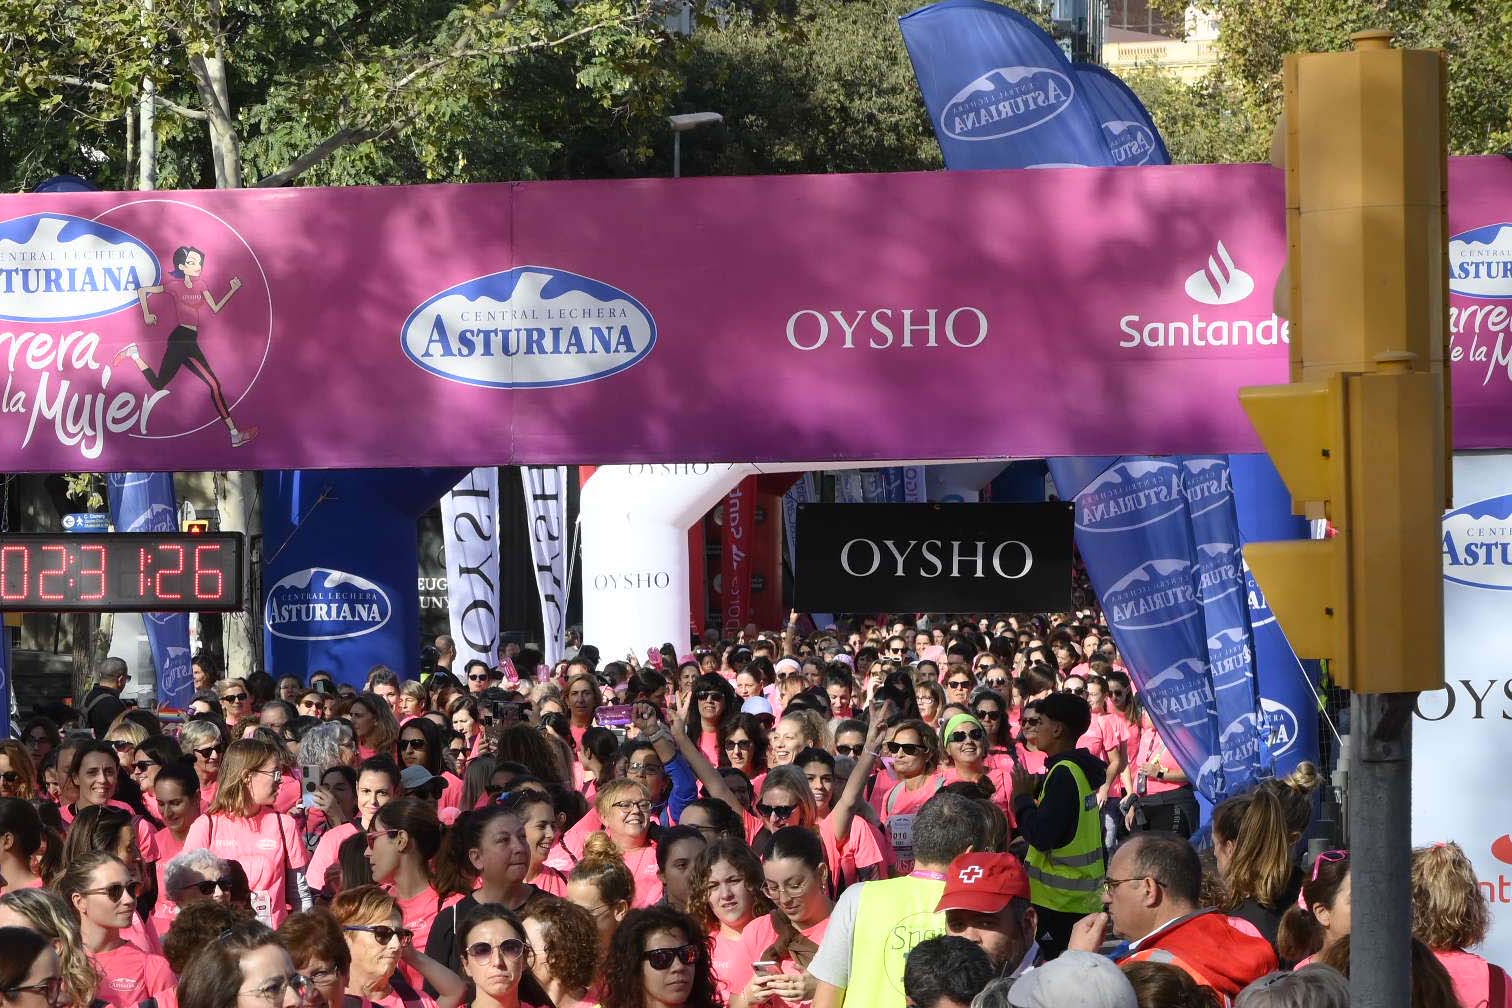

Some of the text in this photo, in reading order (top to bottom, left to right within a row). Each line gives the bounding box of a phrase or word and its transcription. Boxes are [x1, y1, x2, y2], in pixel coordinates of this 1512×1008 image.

[63, 249, 136, 260] LECHERA
[460, 307, 629, 321] CENTRAL LECHERA
[786, 305, 989, 350] OYSHO
[421, 312, 636, 360] ASTURIANA
[1119, 313, 1292, 349] Santande
[0, 370, 25, 413] la
[22, 365, 170, 459] Mujer
[840, 538, 1034, 579] OYSHO
[328, 592, 377, 600] LECHERA
[593, 572, 670, 592] OYSHO
[269, 596, 382, 625] ASTURIANA
